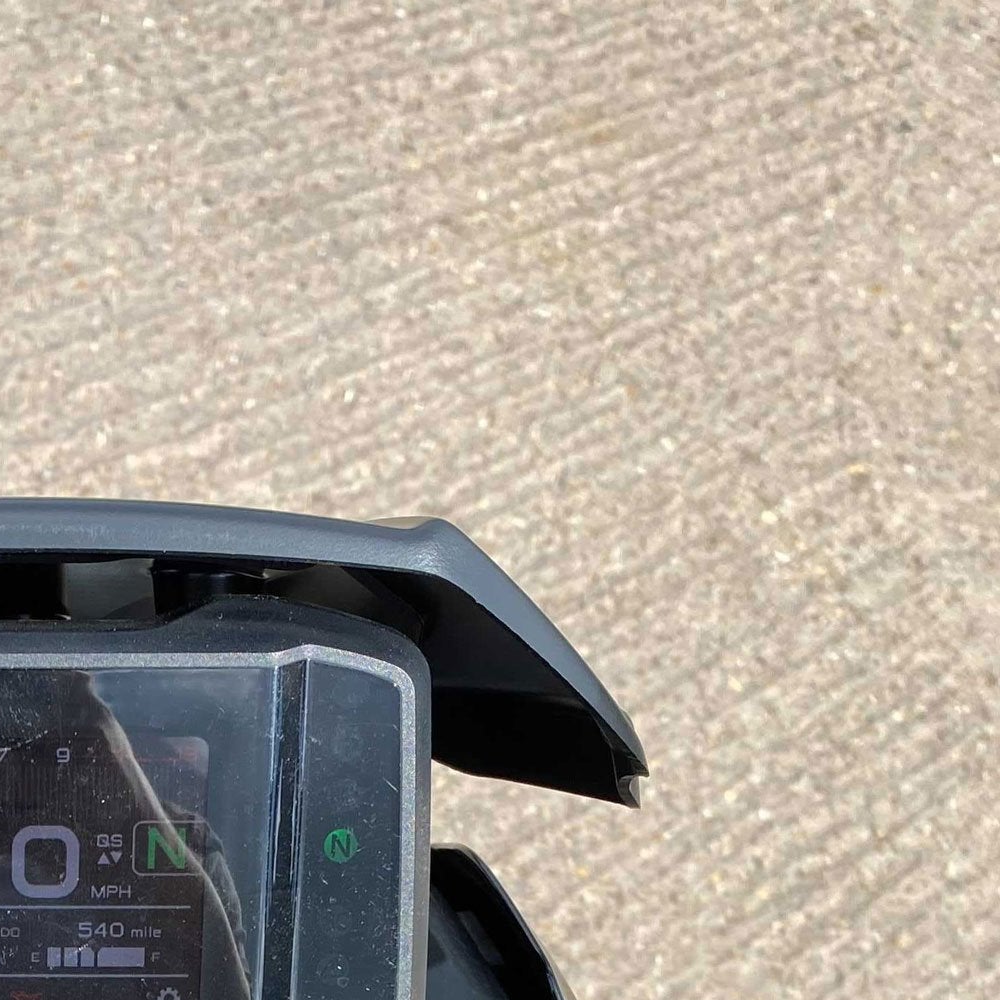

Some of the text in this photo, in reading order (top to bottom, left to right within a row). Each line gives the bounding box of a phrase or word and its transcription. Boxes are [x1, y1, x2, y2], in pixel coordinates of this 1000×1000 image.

[56, 747, 70, 763] 9
[96, 833, 123, 848] QS
[147, 826, 186, 870] N
[11, 825, 80, 899] 0
[91, 885, 131, 899] MPH
[77, 922, 162, 939] 540 mile
[31, 952, 40, 963] E
[151, 952, 160, 963] F
